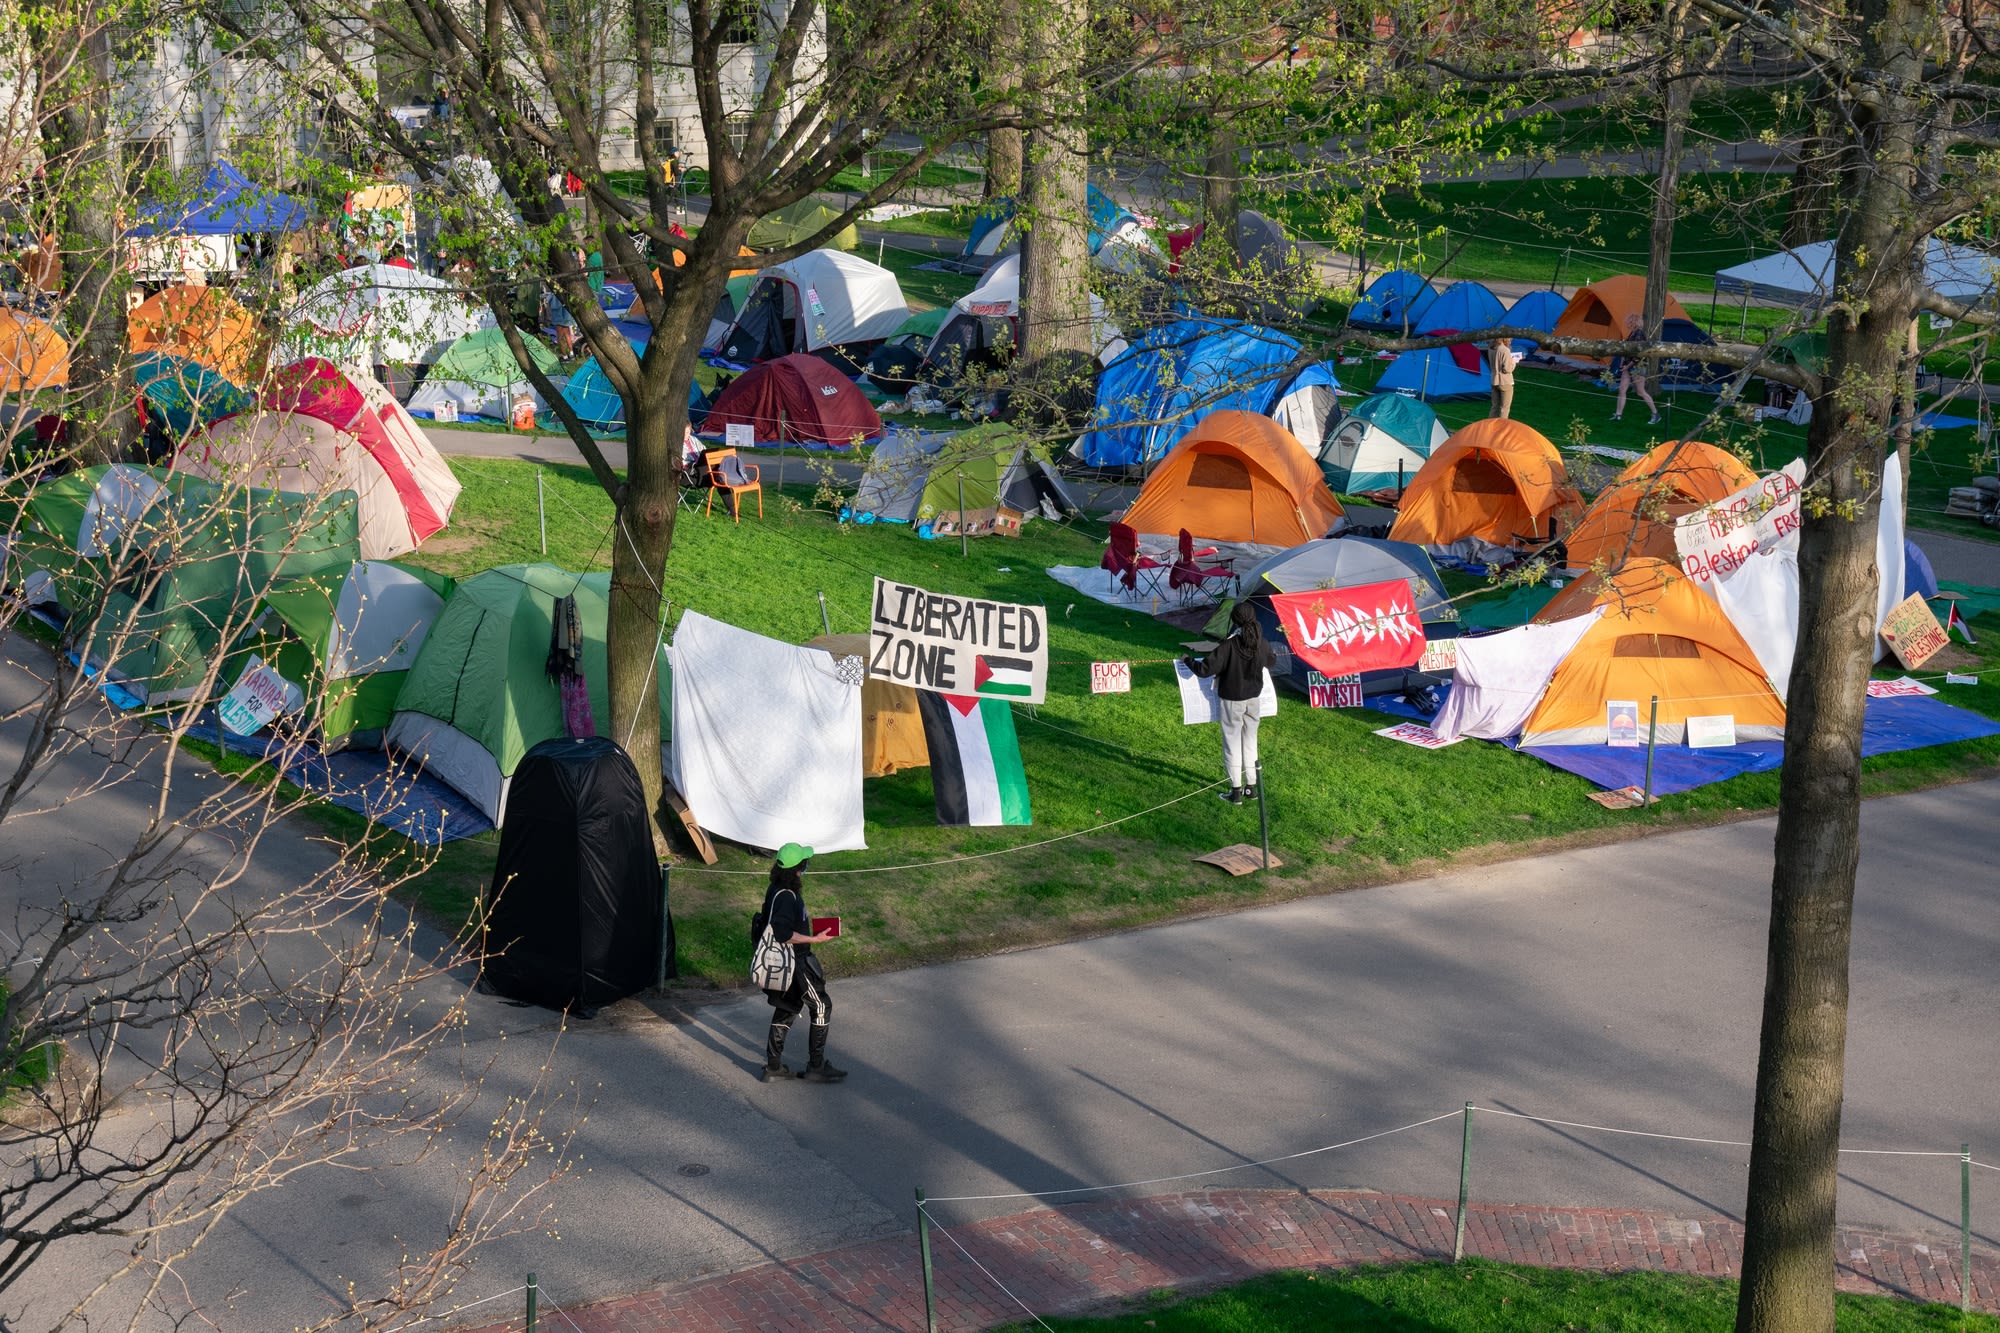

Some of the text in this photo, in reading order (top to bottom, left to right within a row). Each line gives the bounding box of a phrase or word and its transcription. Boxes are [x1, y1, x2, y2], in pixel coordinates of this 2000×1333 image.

[1686, 539, 1759, 583] Palestine
[874, 580, 1041, 653] LIBERATED
[1896, 622, 1932, 651] UNIVERSITY
[1903, 626, 1947, 666] PALESTINE
[870, 630, 956, 690] ZONE
[1094, 663, 1128, 678] FUCK
[1419, 651, 1457, 670] PALESTINA
[241, 664, 288, 713] HARVARD
[245, 694, 263, 714] FOR
[1310, 683, 1362, 708] DIVEST!
